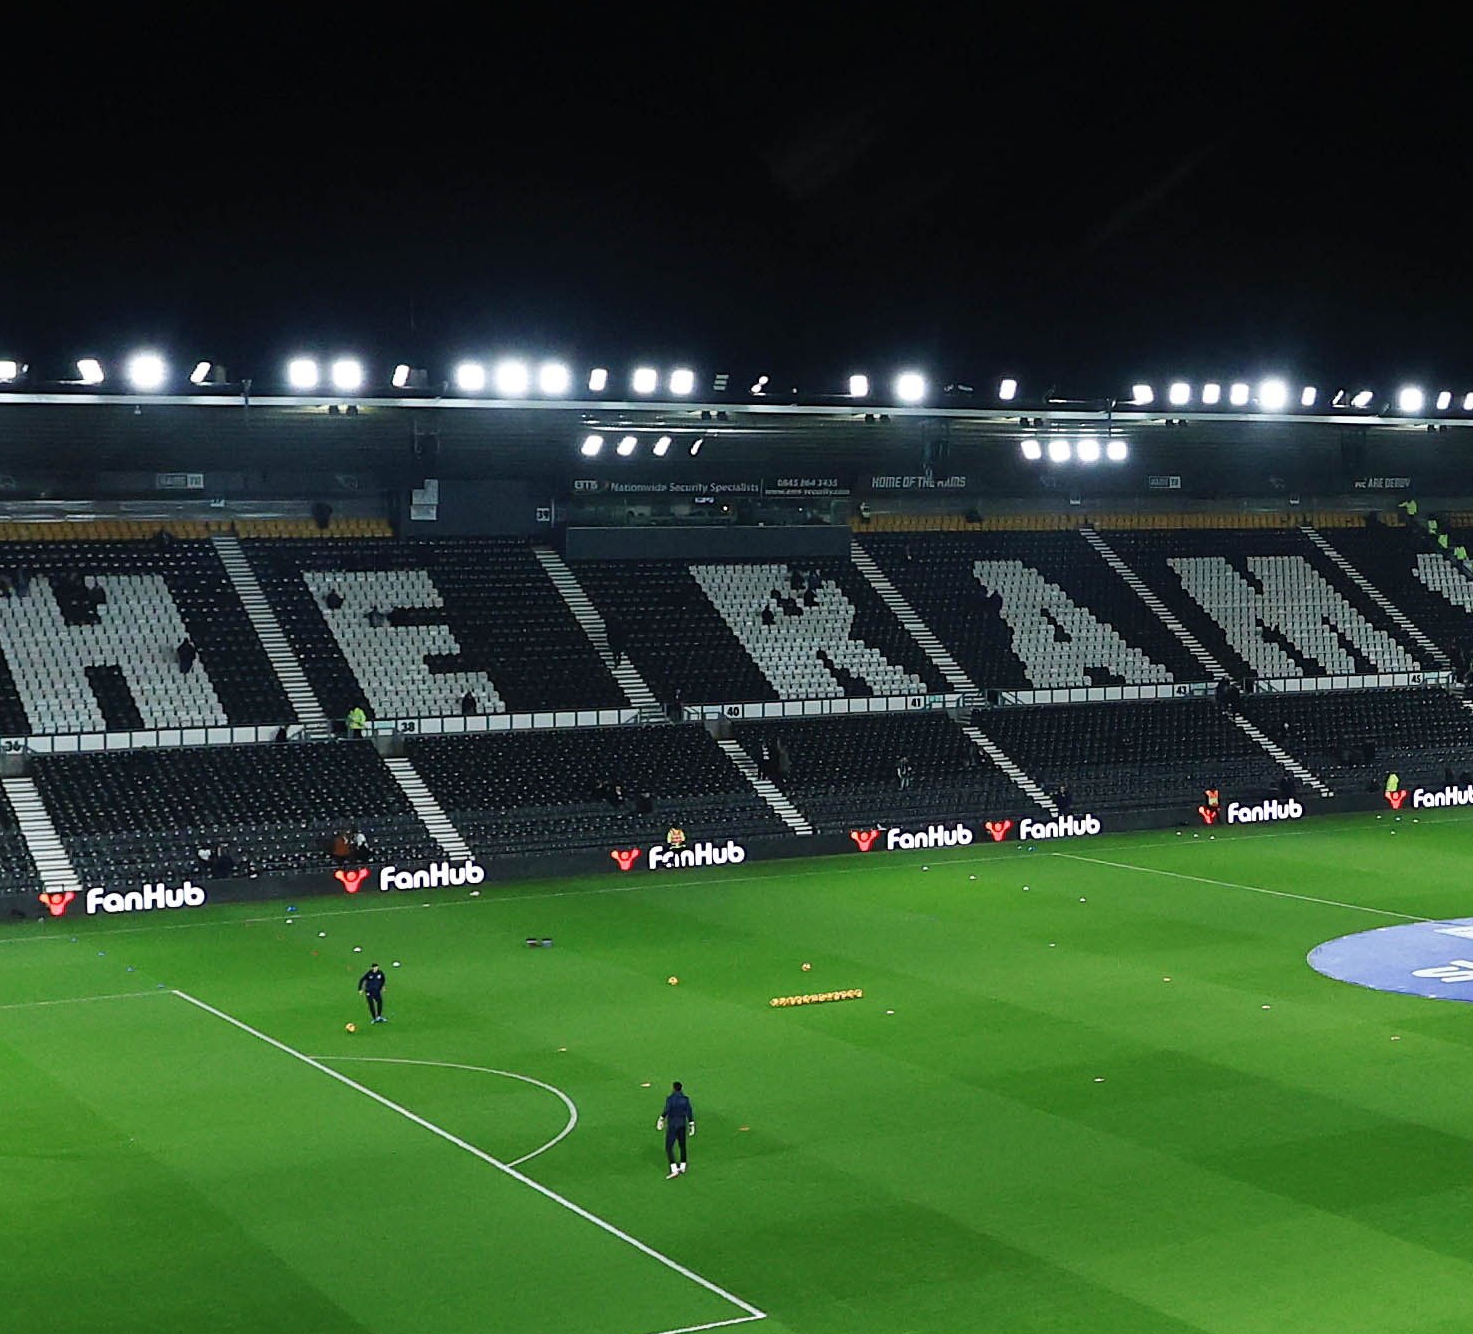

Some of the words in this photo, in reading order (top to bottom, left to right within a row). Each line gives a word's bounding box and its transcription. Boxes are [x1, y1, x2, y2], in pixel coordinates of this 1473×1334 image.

[610, 482, 668, 492] Nationwide
[669, 482, 708, 495] Security
[709, 482, 759, 494] Specialists
[871, 475, 901, 488] HOME
[902, 476, 917, 488] OF
[726, 706, 740, 717] 40
[1227, 798, 1303, 824] FanHub
[886, 825, 973, 851] FanHub
[1020, 813, 1102, 840] FanHub
[380, 863, 485, 893] FanHub
[86, 881, 206, 915] FanHub
